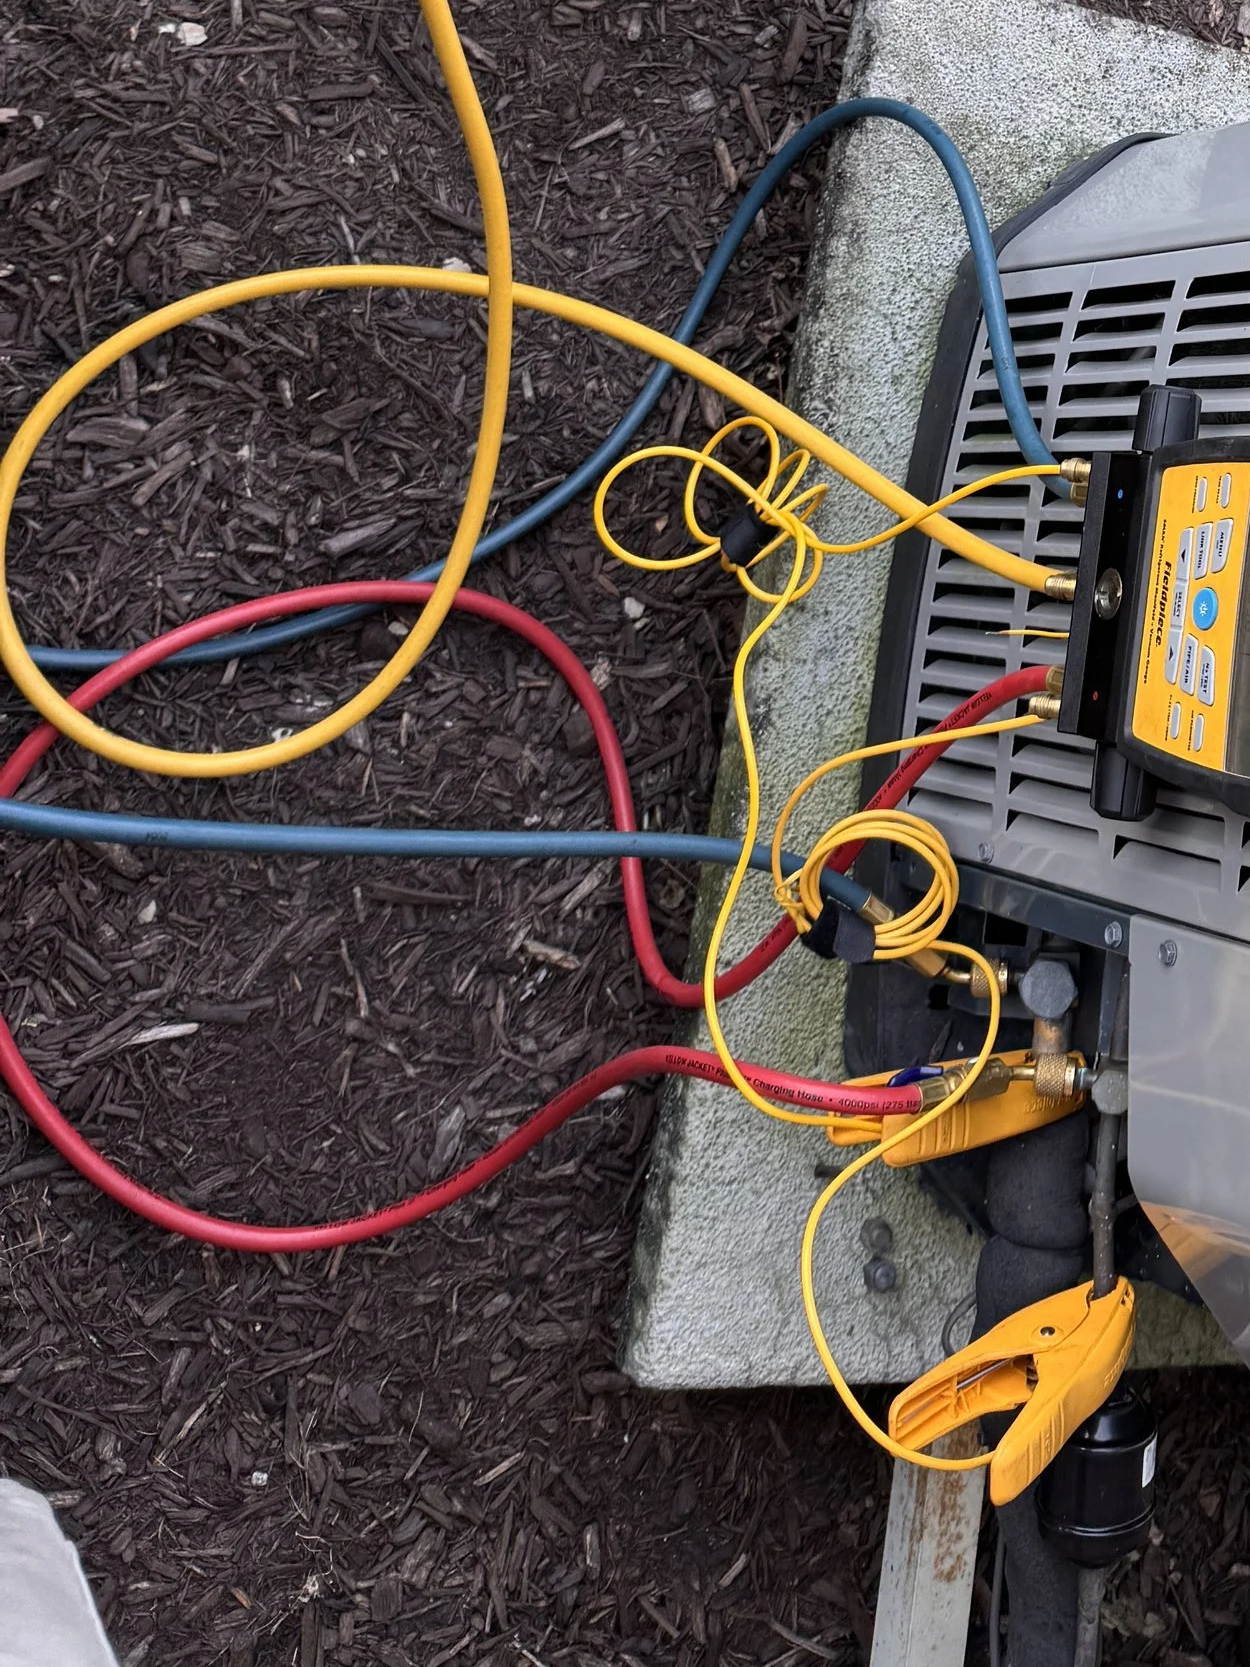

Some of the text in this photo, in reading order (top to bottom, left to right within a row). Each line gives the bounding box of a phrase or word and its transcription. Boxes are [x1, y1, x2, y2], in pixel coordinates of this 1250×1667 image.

[1155, 560, 1173, 647] Fieldpiece
[1183, 644, 1193, 685] PIPE/AIR
[752, 1077, 795, 1098] Charging
[796, 1089, 824, 1103] Hose
[837, 1095, 880, 1110] 4000psi
